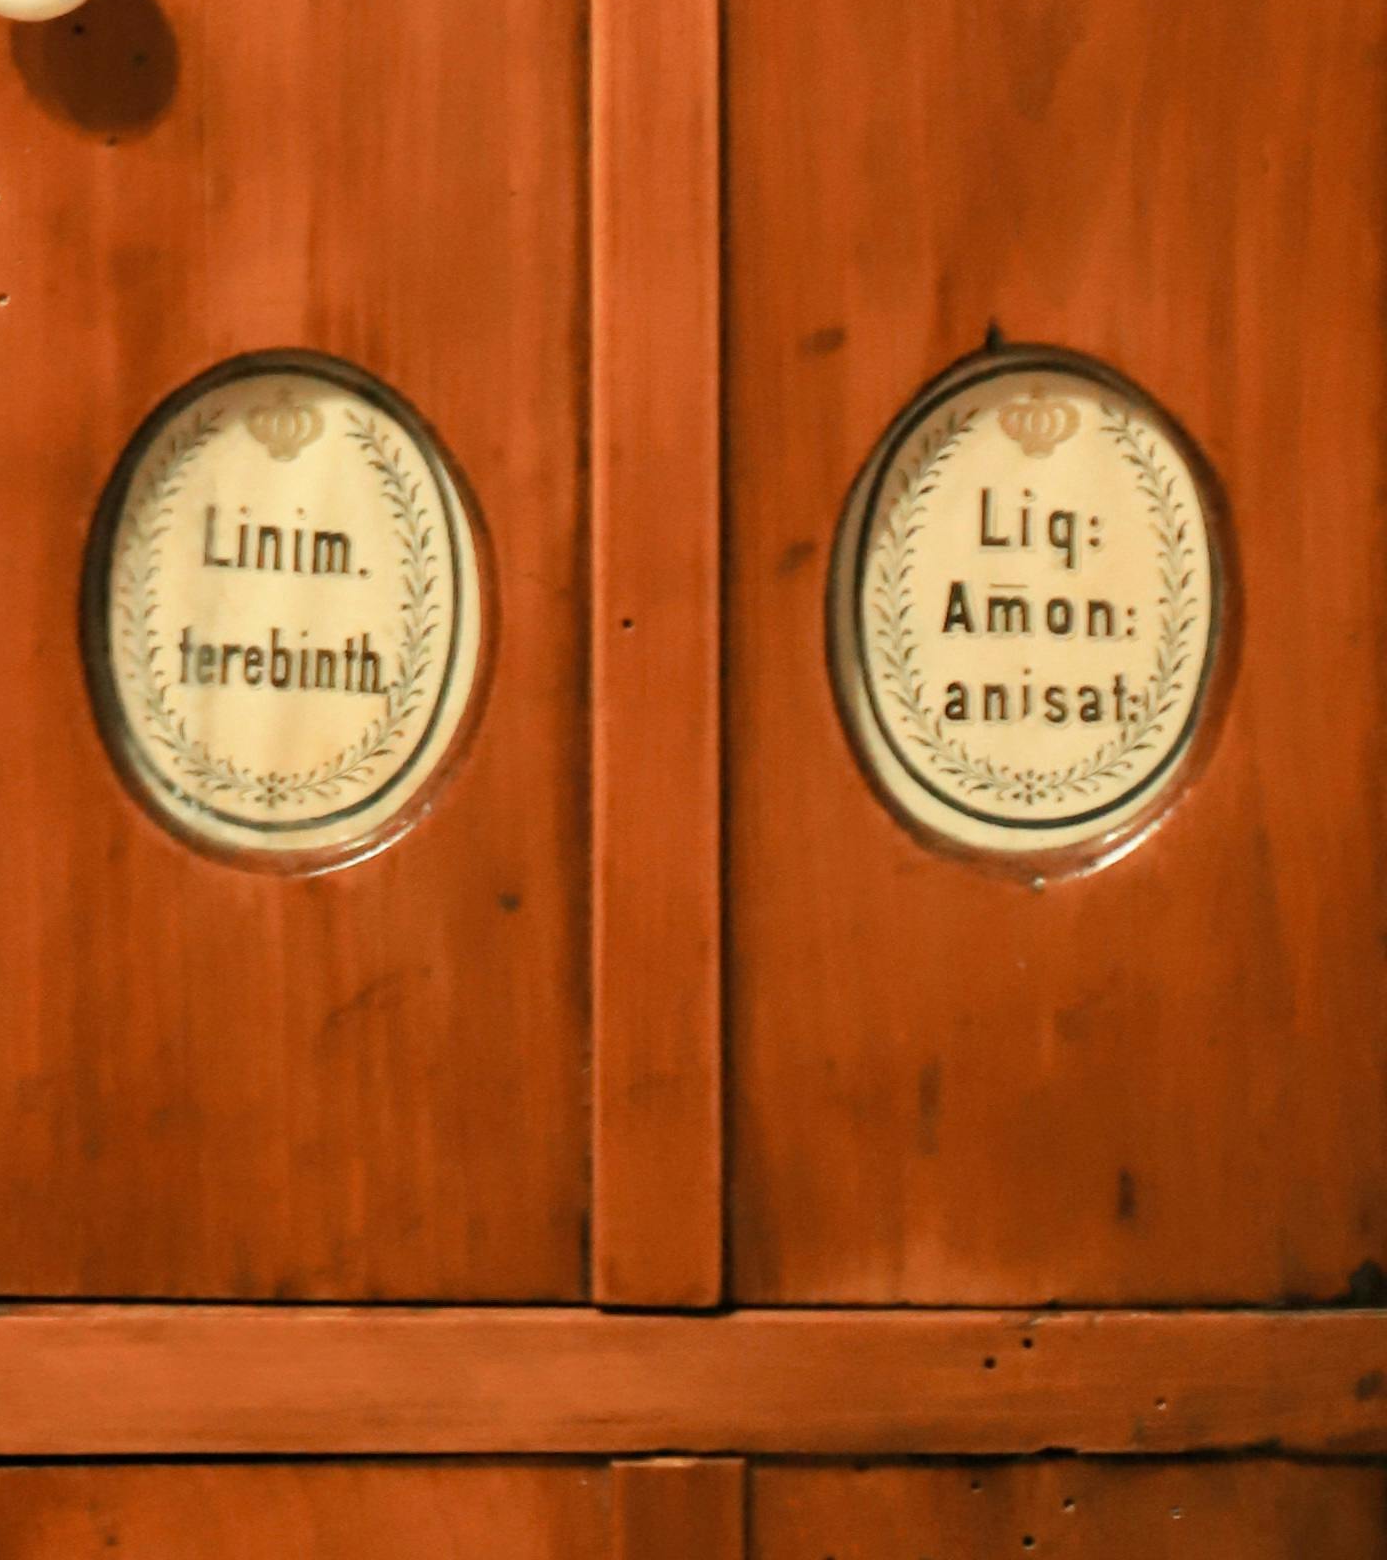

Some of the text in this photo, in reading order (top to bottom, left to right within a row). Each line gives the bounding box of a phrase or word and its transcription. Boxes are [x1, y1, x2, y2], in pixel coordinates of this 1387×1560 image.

[203, 506, 370, 578] Linim.
[979, 488, 1101, 568] Liq:
[179, 627, 398, 693] terebinth.
[944, 667, 1139, 723] anisat:
